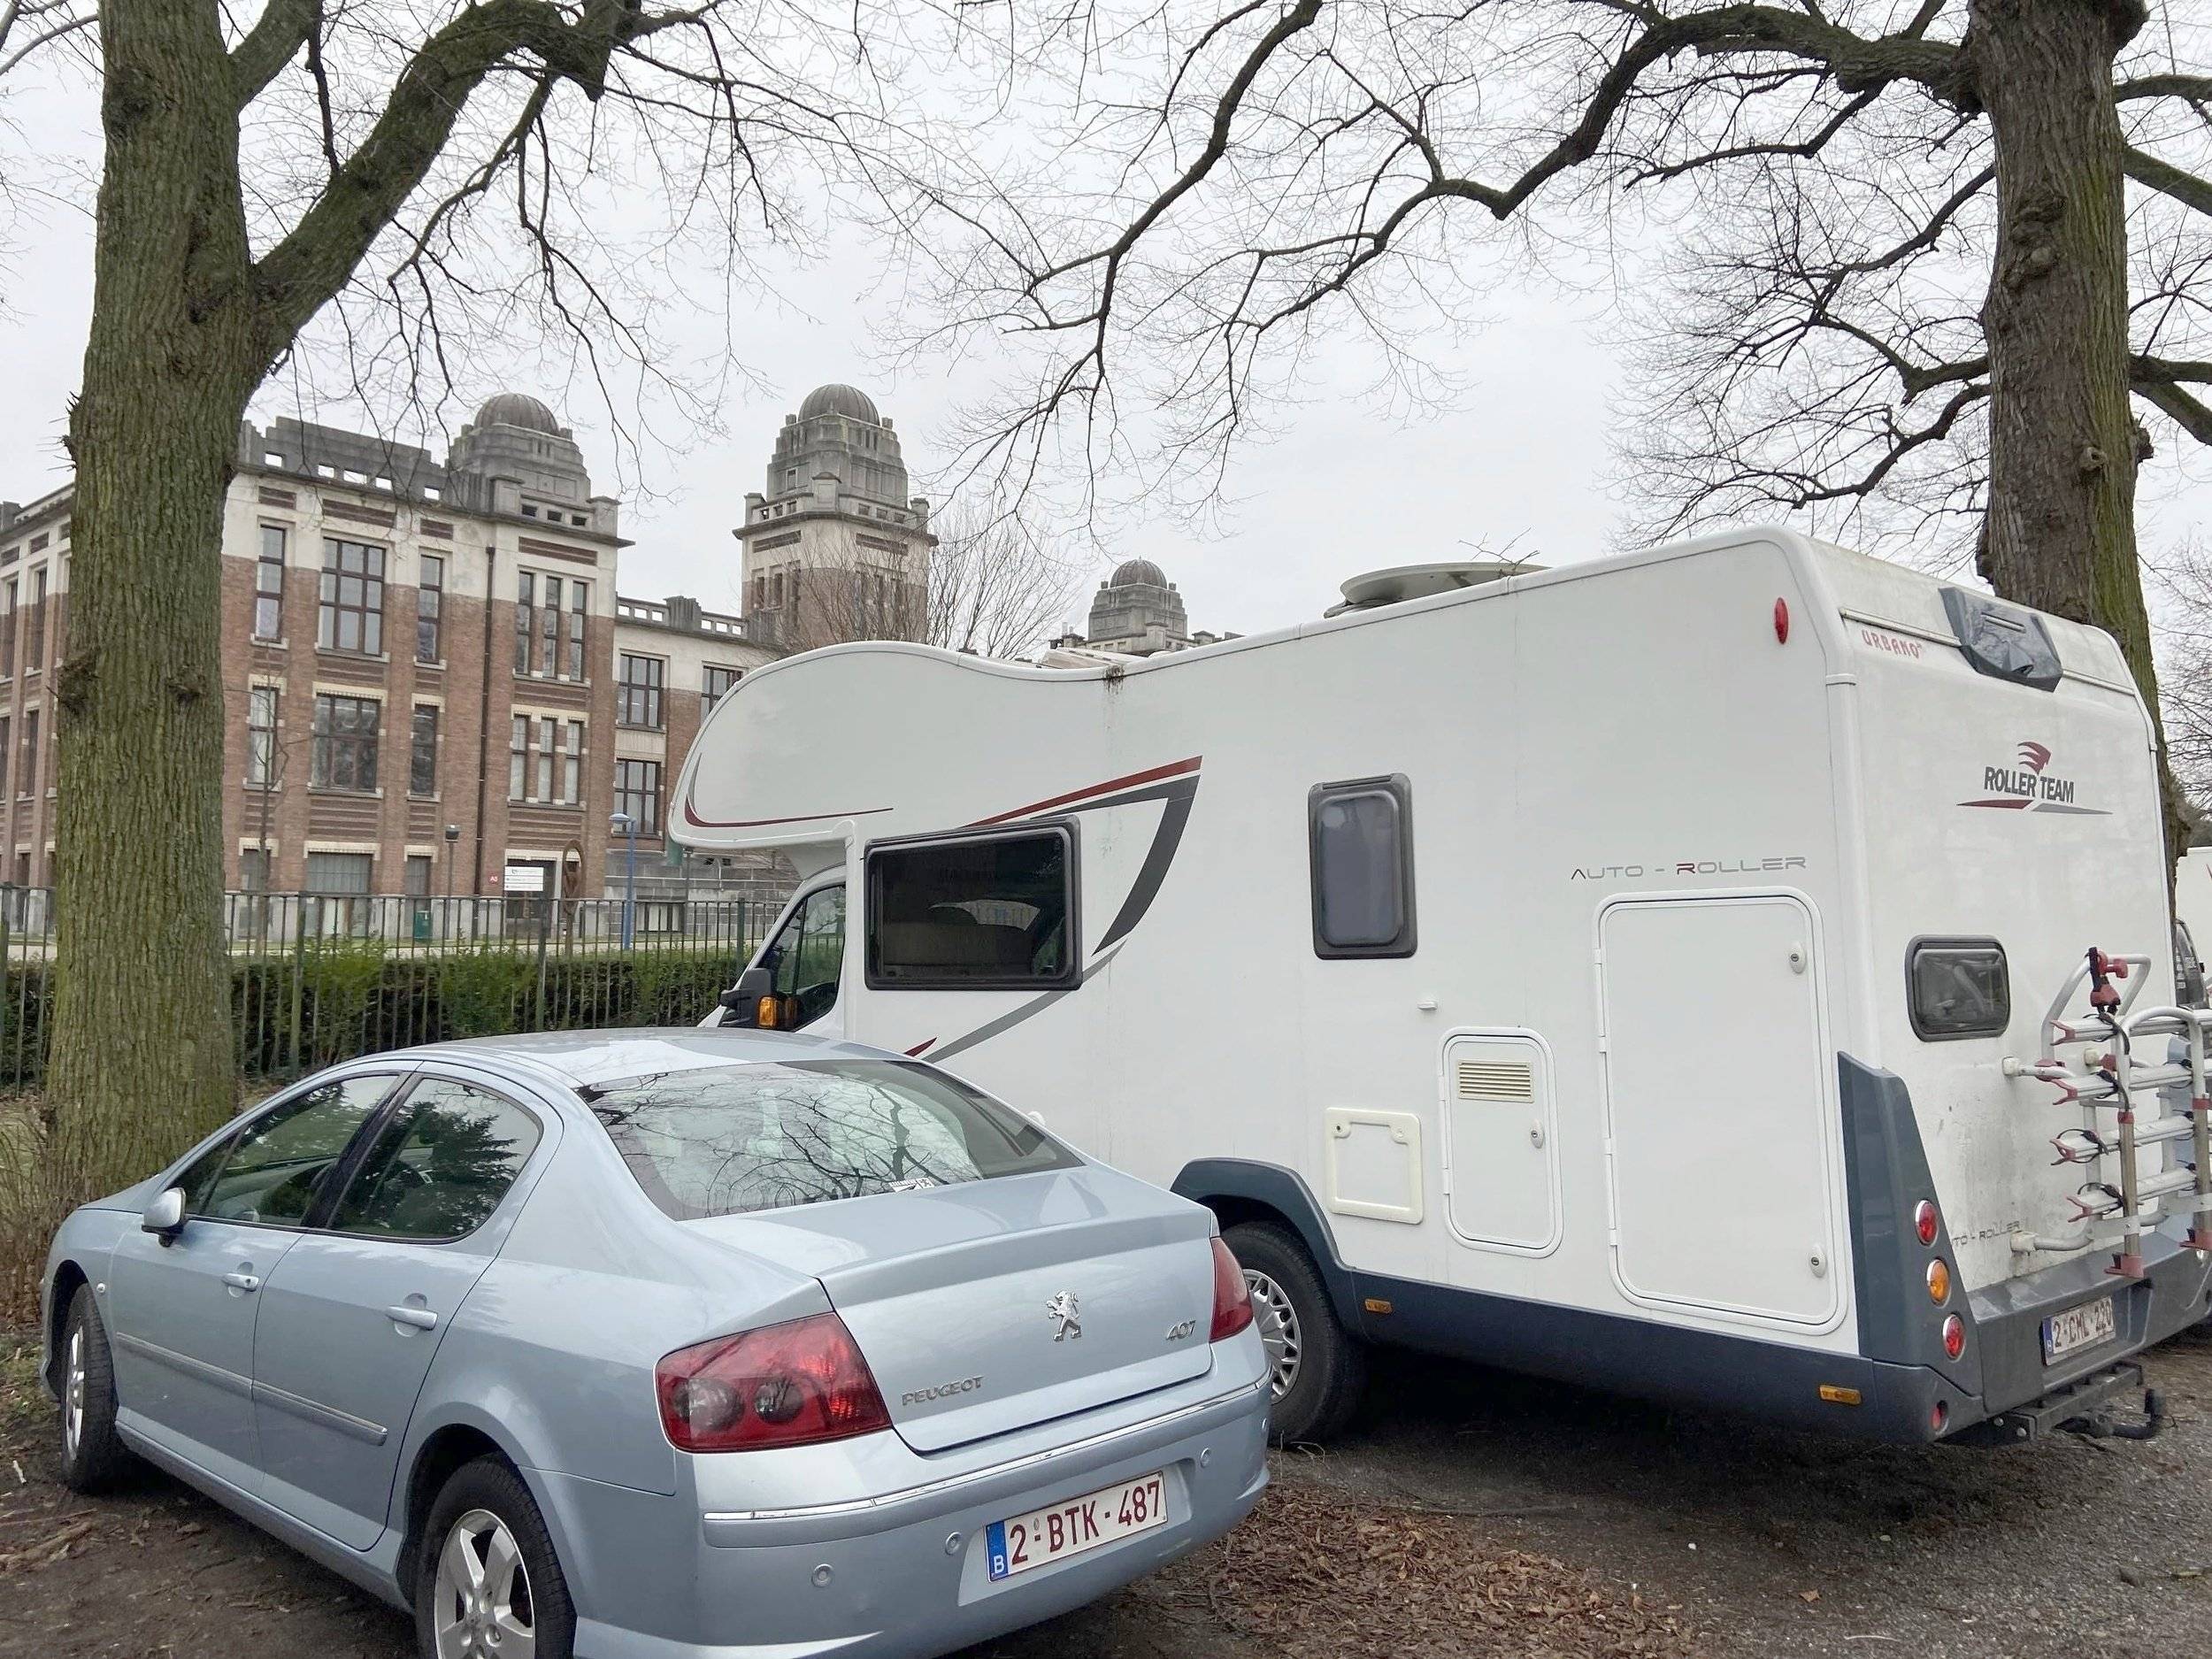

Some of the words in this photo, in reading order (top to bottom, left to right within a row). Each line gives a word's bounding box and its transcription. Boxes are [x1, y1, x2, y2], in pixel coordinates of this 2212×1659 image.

[1861, 629, 1920, 659] URBANO
[1984, 766, 2037, 797] ROLLER
[2039, 776, 2074, 803] TEAM
[1571, 864, 1644, 880] AUTO
[1676, 856, 1807, 875] ROLLER
[1978, 1220, 2021, 1241] ROLLER
[1166, 1320, 1196, 1340] 407
[902, 1375, 984, 1406] PEUGEOT
[1009, 1480, 1162, 1566] 2-BTK-487
[993, 1555, 1005, 1574] B
